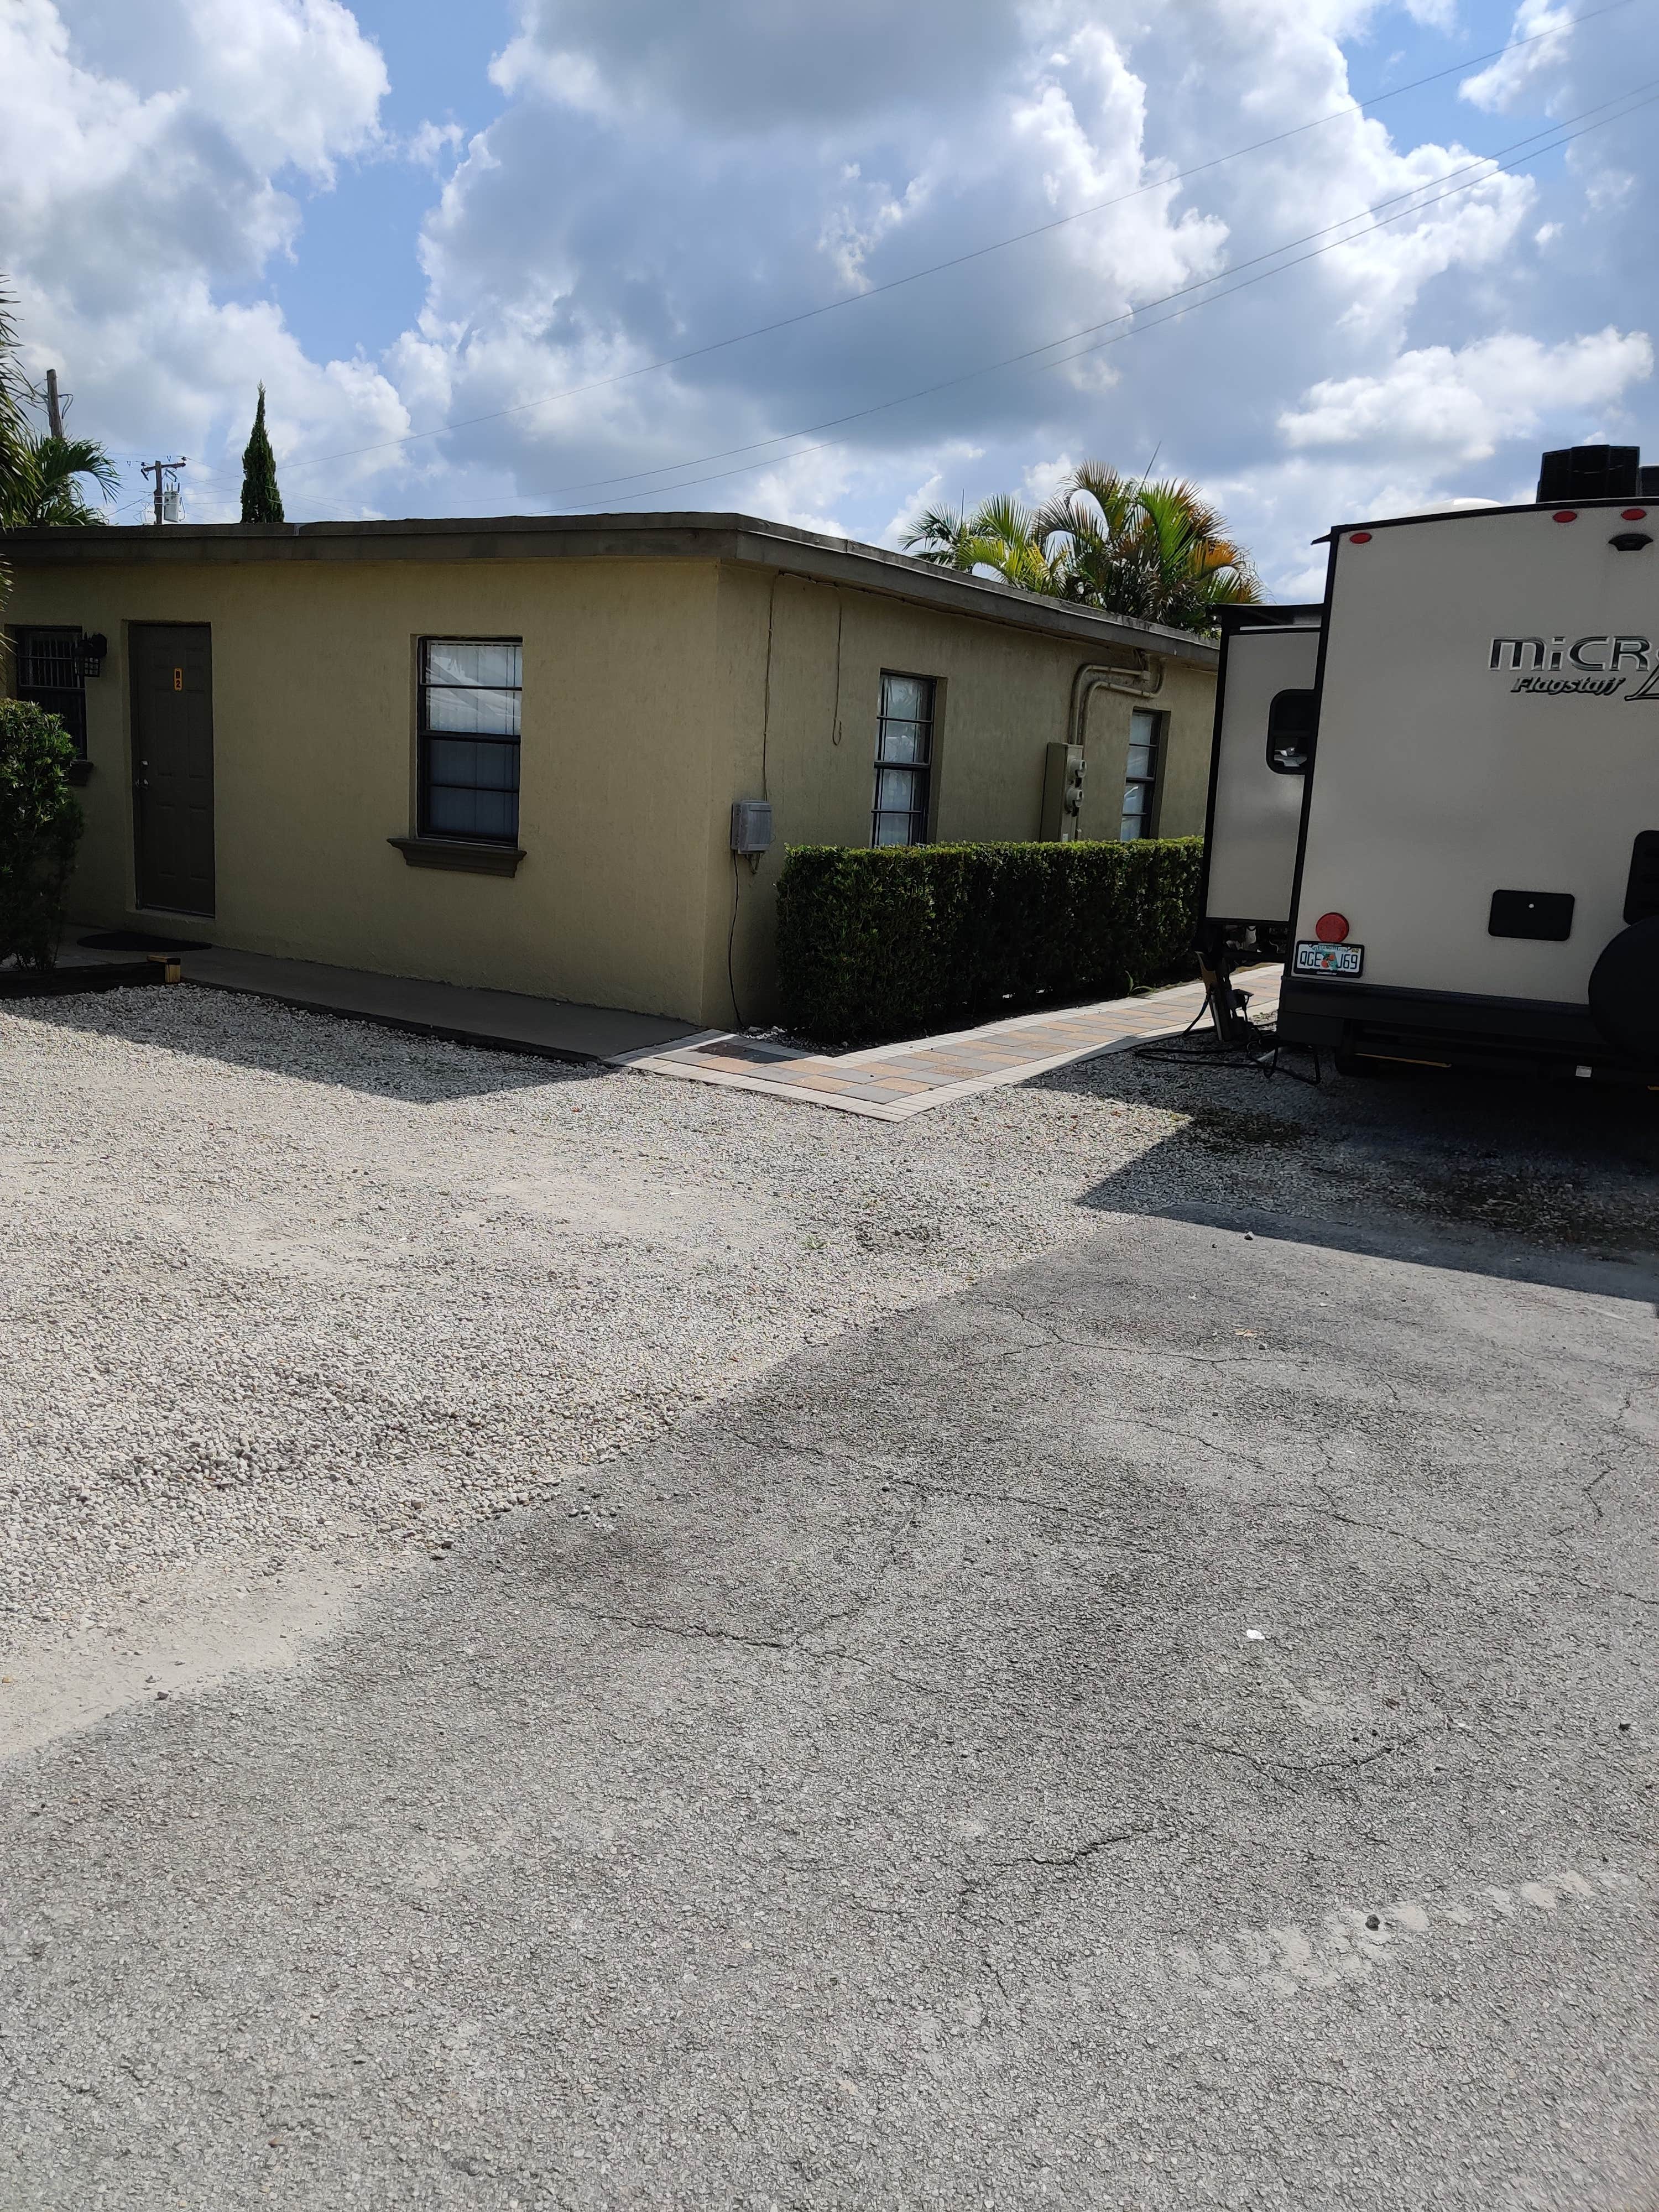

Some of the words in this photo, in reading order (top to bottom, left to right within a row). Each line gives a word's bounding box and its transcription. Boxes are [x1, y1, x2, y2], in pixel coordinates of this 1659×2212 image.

[1489, 636, 1659, 671] MiCR
[1510, 676, 1626, 695] Flagstaff
[1300, 951, 1322, 967] QGE
[1337, 953, 1358, 969] J69
